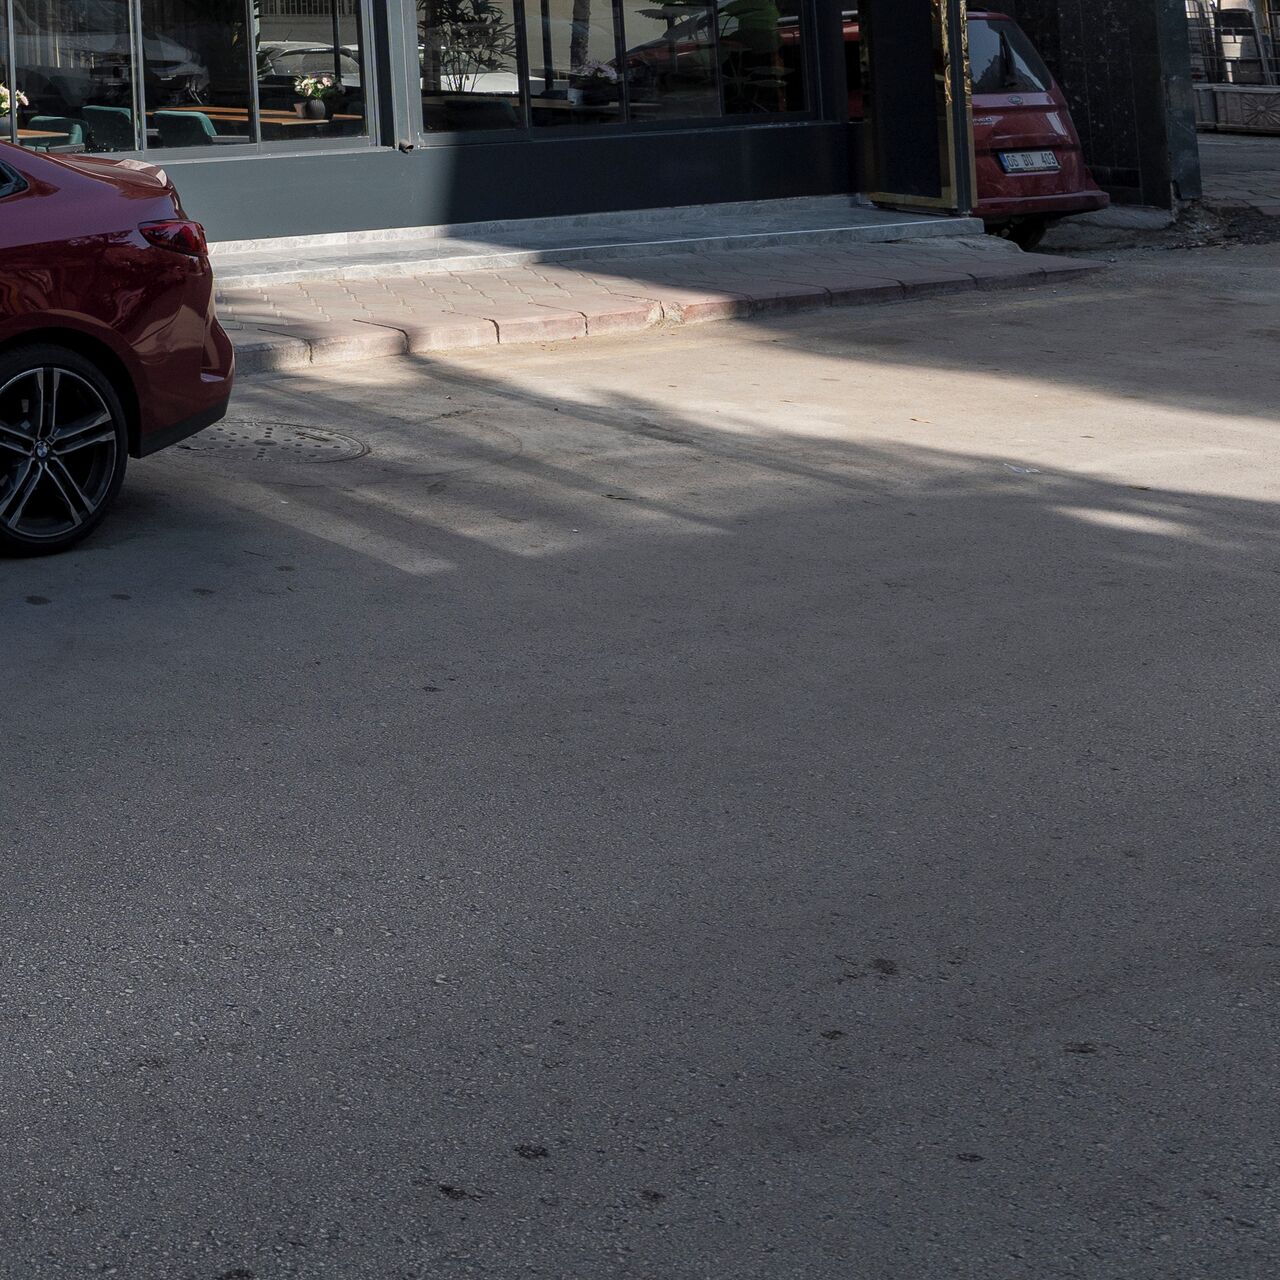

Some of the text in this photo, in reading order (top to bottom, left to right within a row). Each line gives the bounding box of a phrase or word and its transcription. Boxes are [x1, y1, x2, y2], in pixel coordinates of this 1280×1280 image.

[1005, 152, 1057, 167] 06 BU 403
